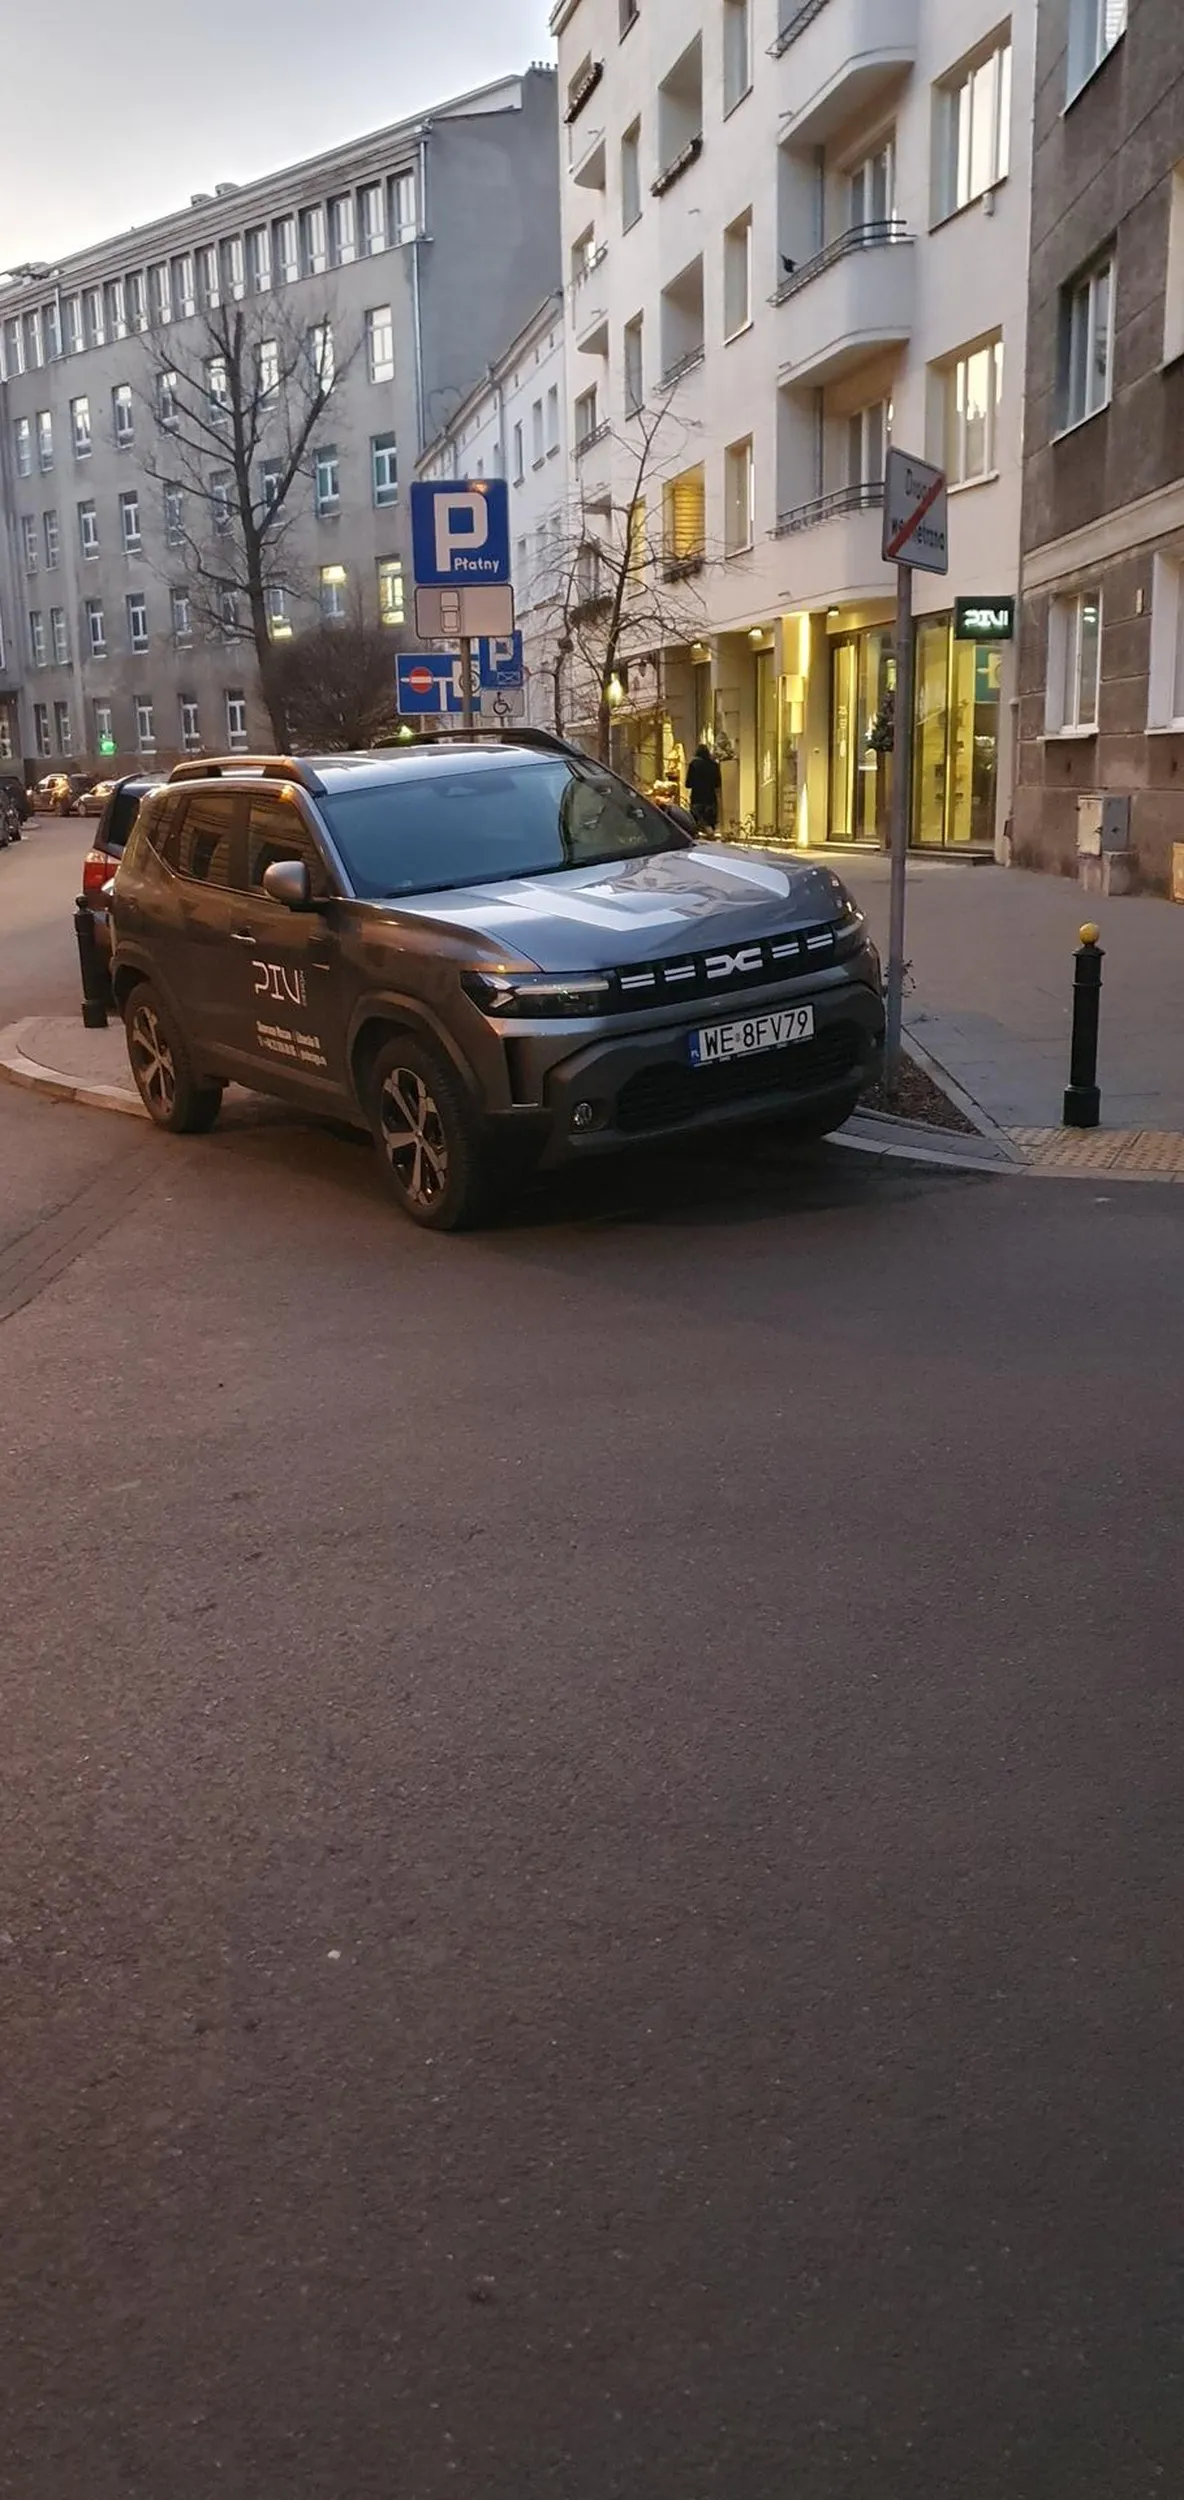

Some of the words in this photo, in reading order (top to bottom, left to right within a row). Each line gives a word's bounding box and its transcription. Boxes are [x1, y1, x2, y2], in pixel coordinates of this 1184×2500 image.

[434, 492, 488, 572] P
[454, 557, 500, 573] Płatny
[489, 636, 514, 670] P
[704, 1027, 733, 1057] WE
[742, 1010, 809, 1048] 8FV79
